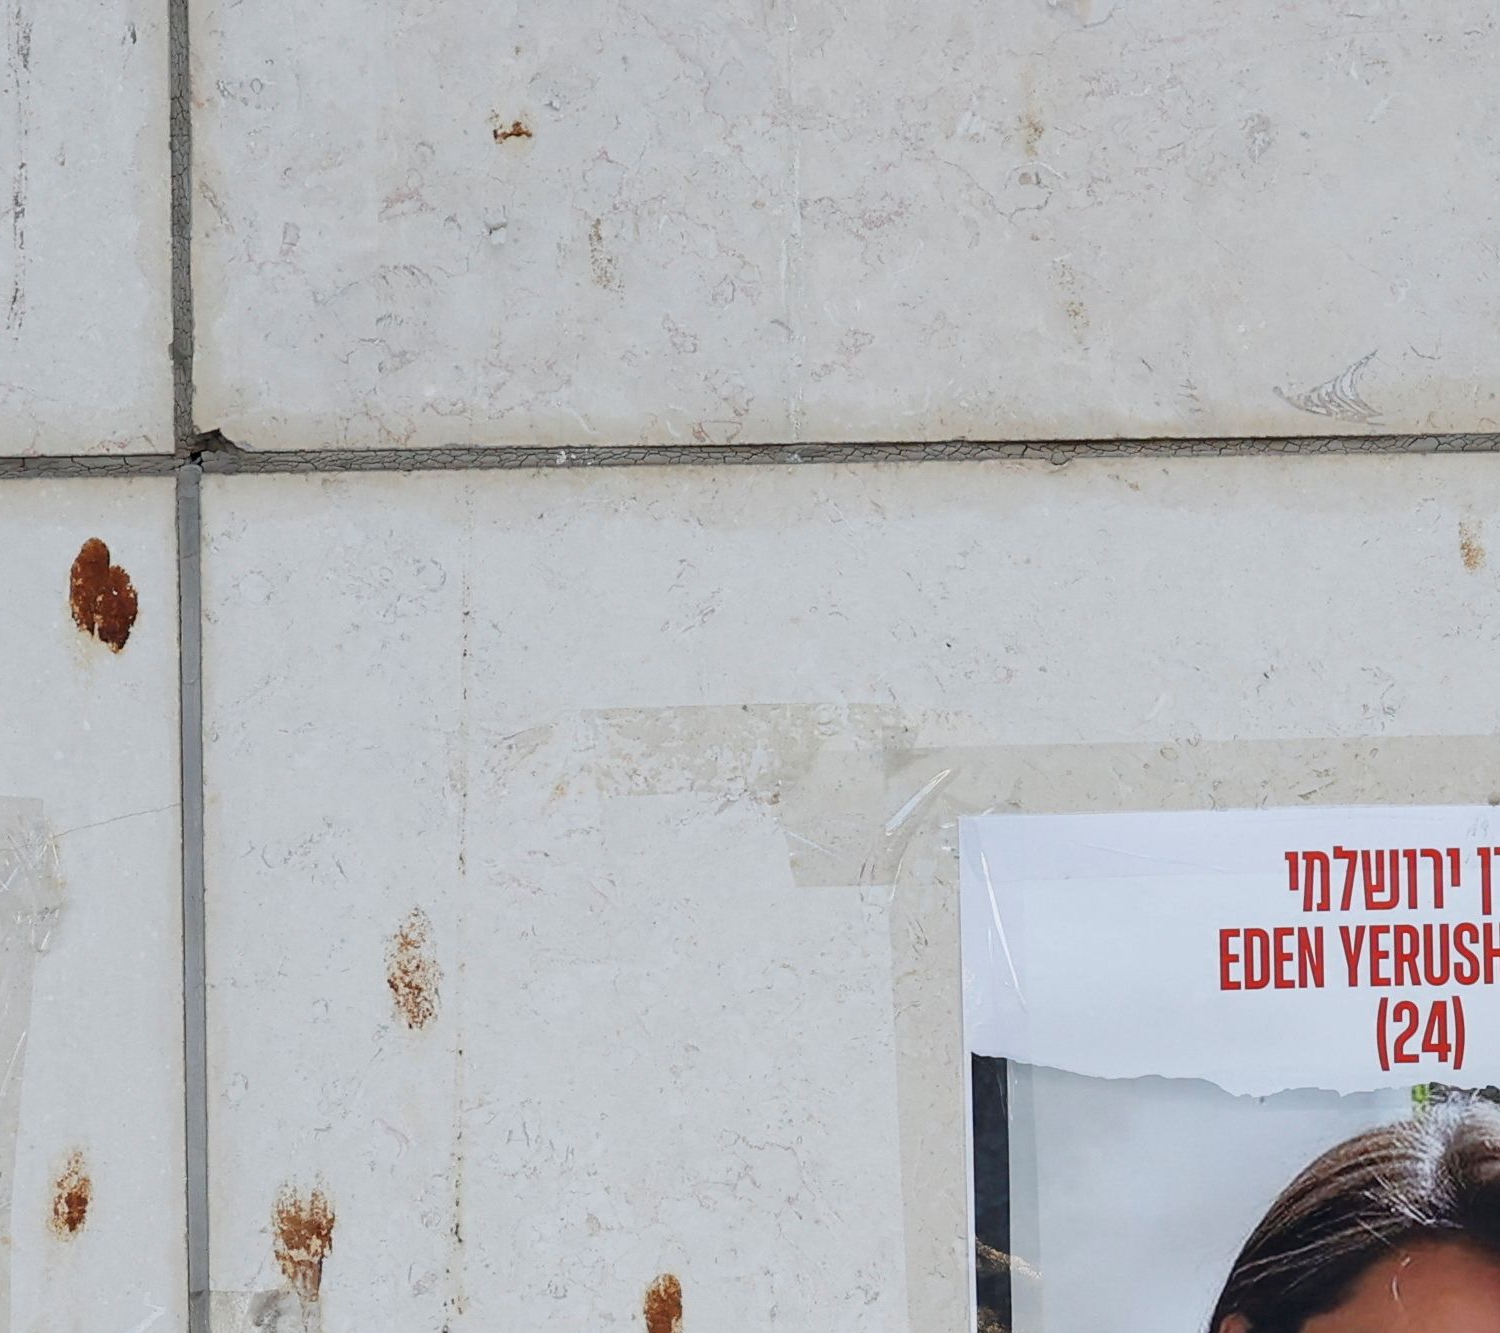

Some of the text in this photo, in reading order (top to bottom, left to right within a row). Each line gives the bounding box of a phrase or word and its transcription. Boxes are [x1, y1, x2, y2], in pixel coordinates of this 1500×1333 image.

[1285, 845, 1461, 911] ירושלמי
[1220, 927, 1325, 990] EDEN
[1376, 995, 1466, 1071] (24)
